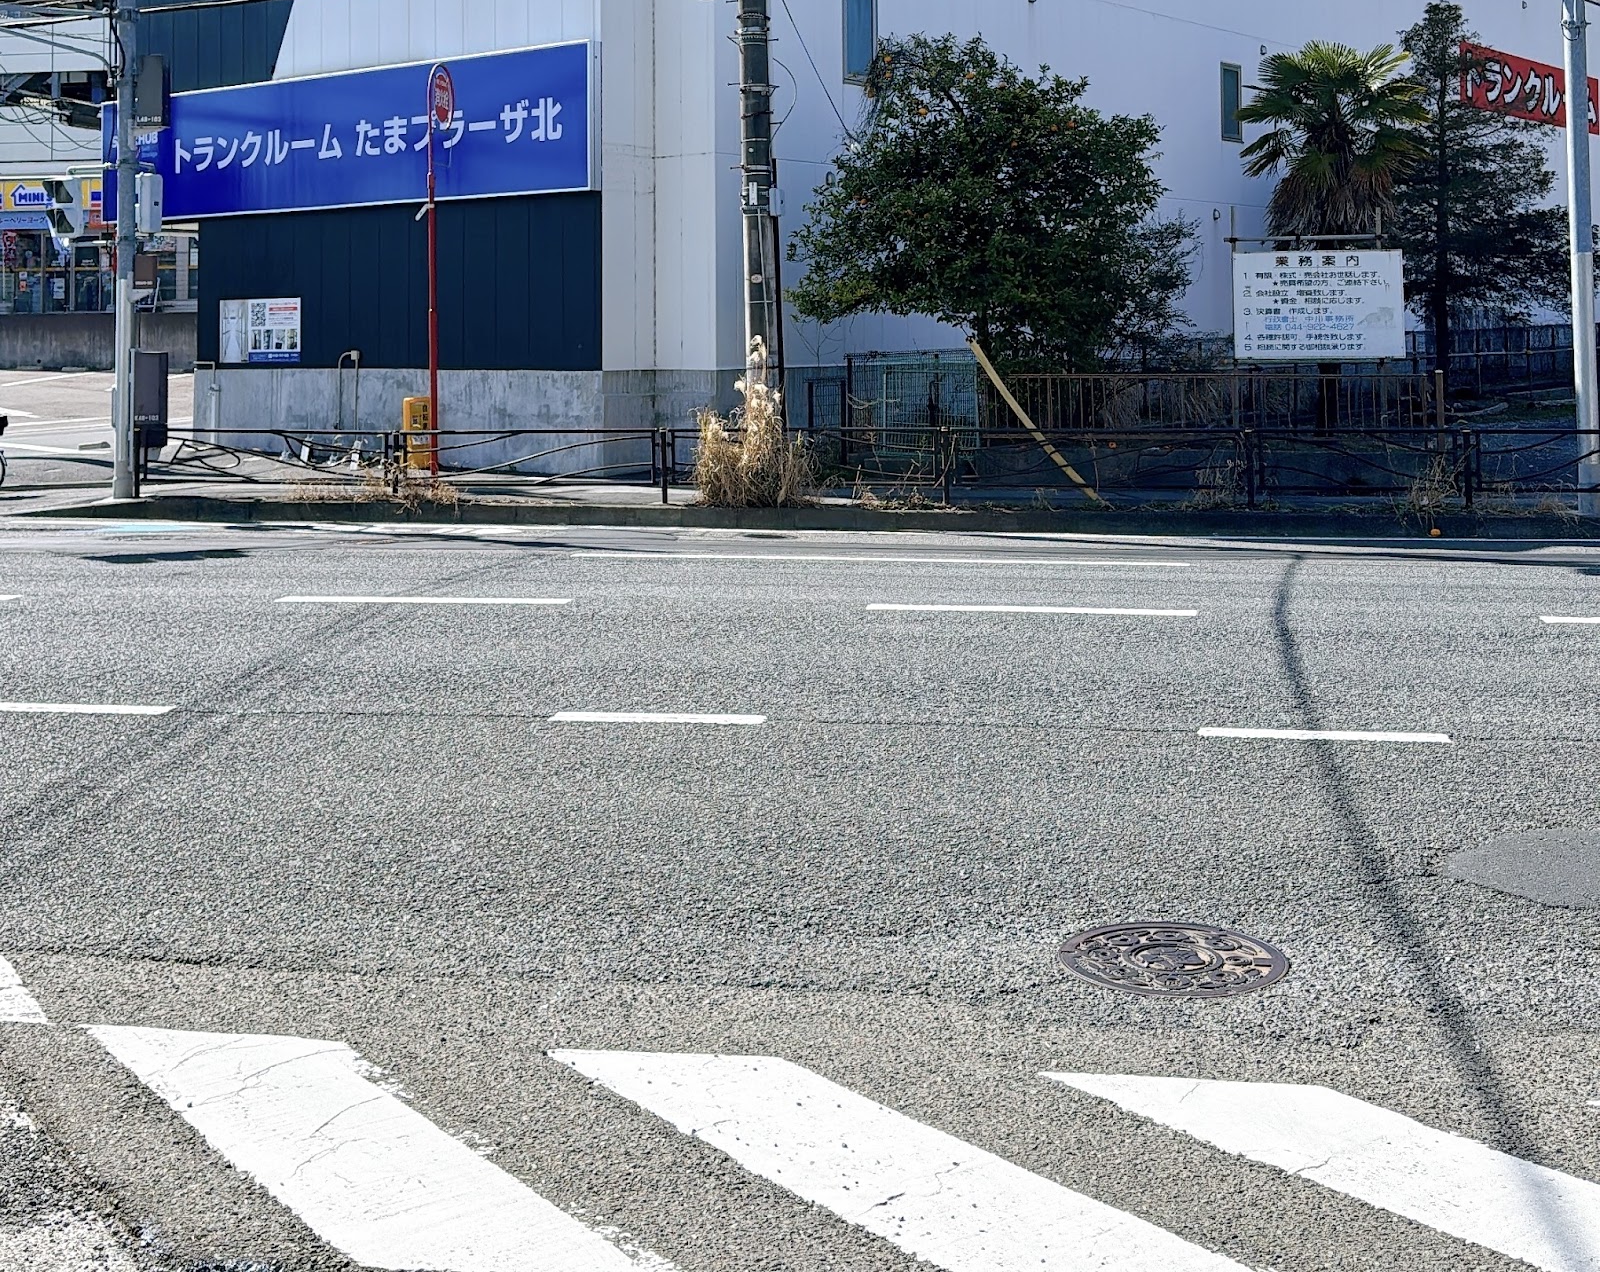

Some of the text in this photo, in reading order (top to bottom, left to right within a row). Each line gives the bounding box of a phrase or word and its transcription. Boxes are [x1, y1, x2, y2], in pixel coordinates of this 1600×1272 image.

[1466, 52, 1597, 124] トランクル
[174, 96, 563, 174] トランクルーム たまプラーザ北
[18, 192, 44, 203] MINI
[1275, 255, 1360, 267] 業務案内
